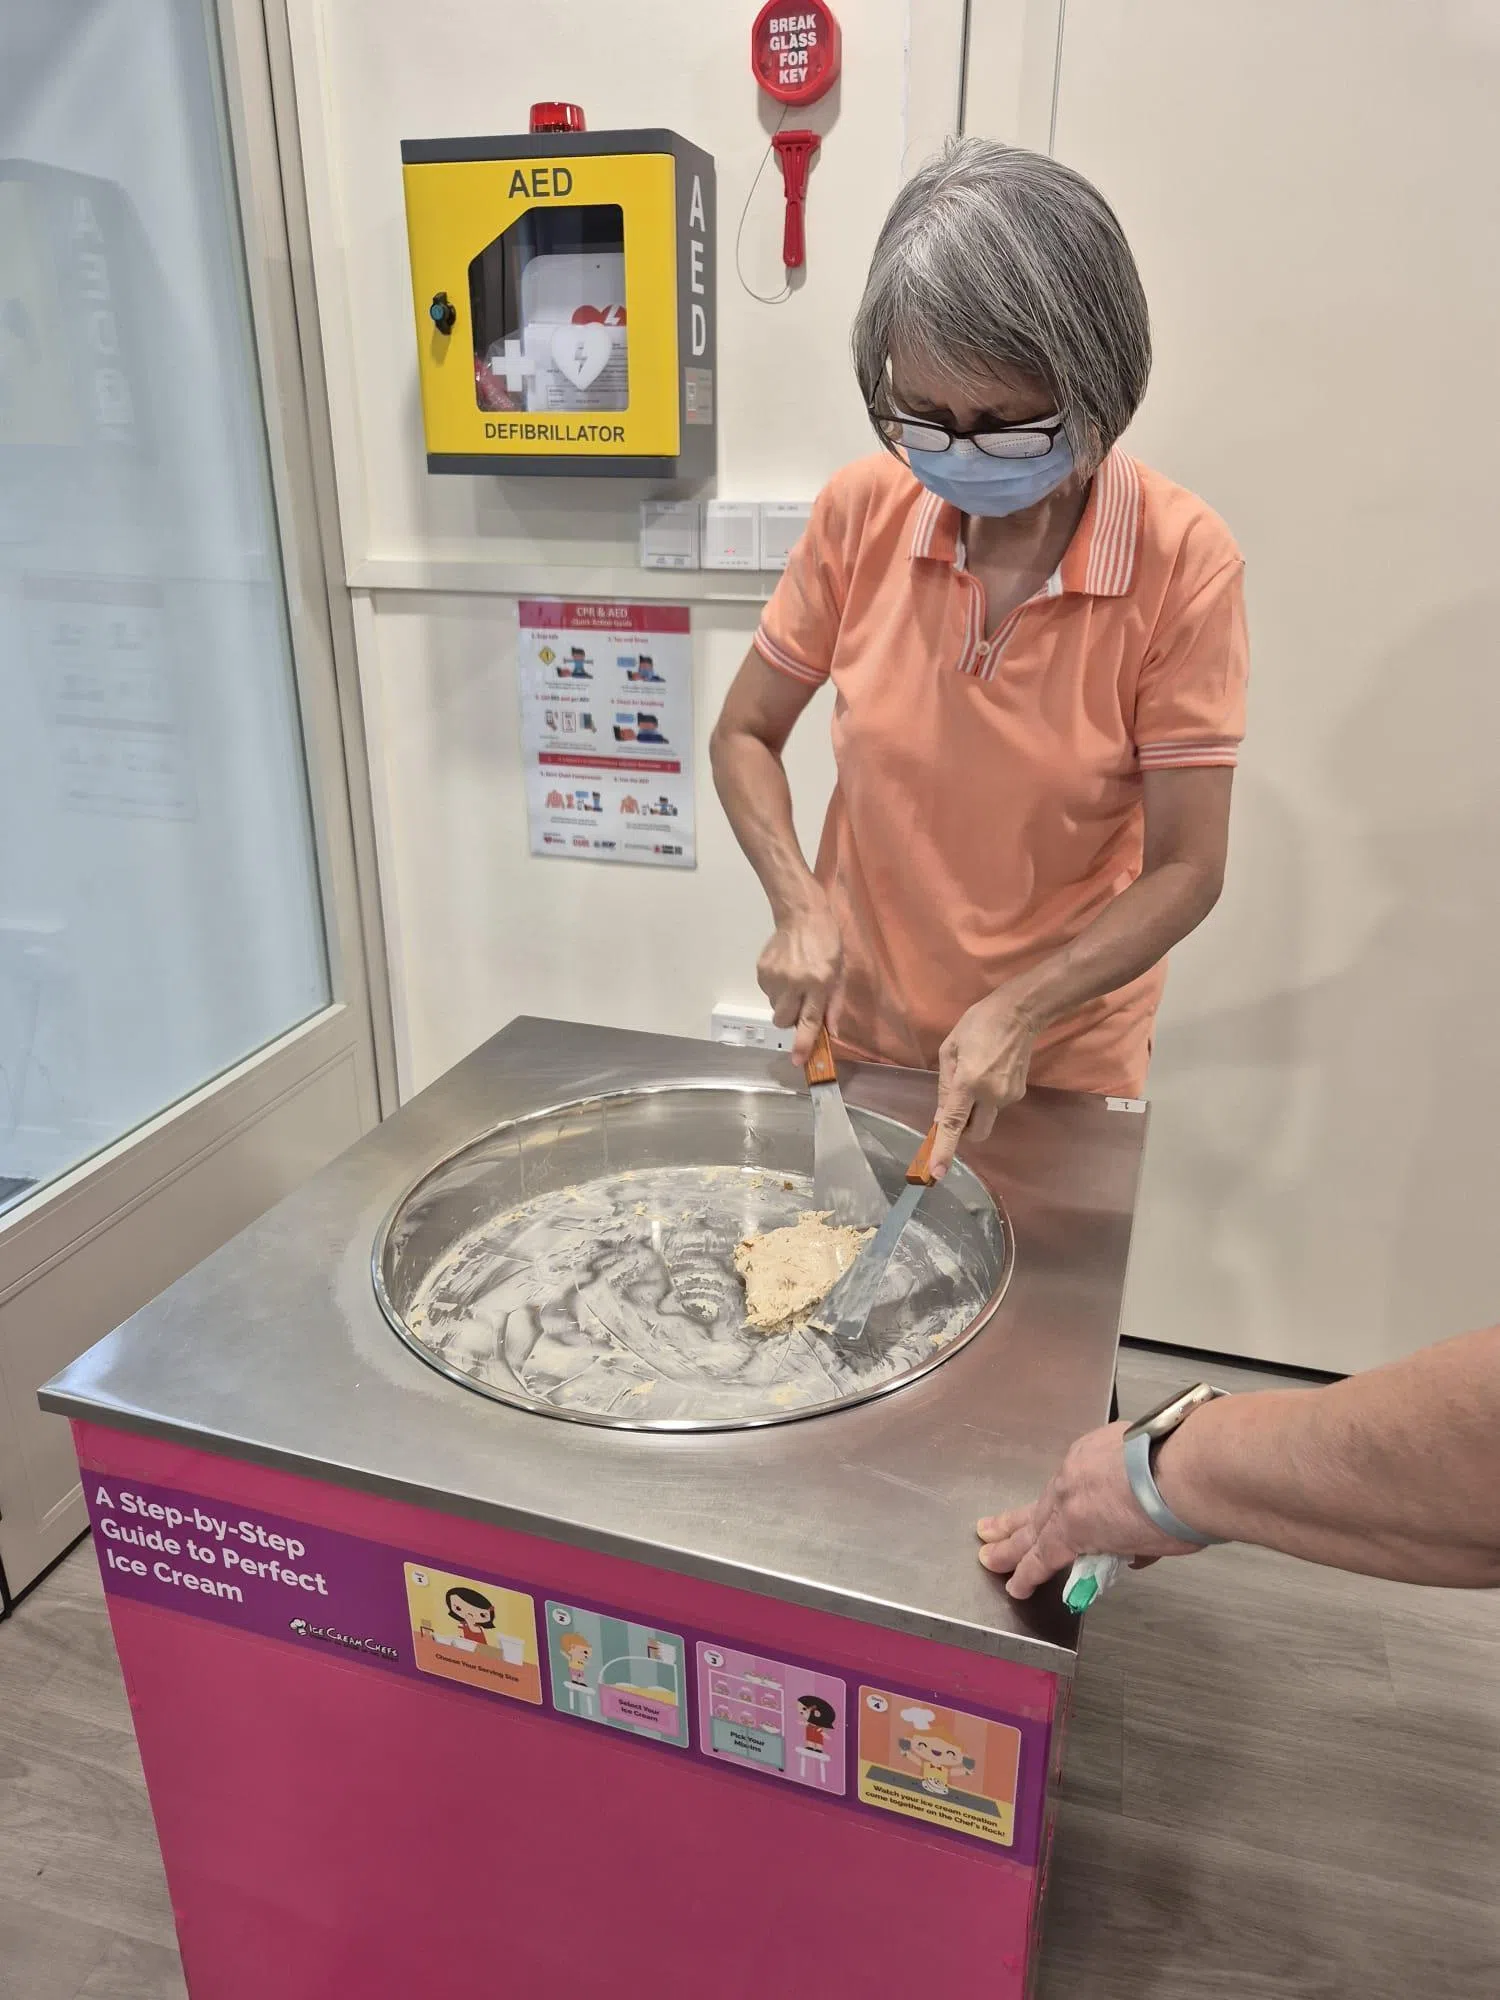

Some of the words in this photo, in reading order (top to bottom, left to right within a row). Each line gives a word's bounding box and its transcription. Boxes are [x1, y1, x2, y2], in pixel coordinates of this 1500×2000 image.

[769, 13, 817, 34] BREAK
[769, 31, 818, 51] GLASS
[779, 50, 809, 67] FOR
[779, 66, 809, 84] KEY
[508, 167, 574, 199] AED
[484, 422, 626, 443] DEFIBRILLATOR
[575, 606, 596, 617] CPR
[598, 607, 606, 617] &
[607, 608, 629, 618] AED
[95, 1485, 115, 1509] A
[119, 1491, 306, 1561] Step-by-Step
[100, 1517, 182, 1556] Guide
[186, 1538, 217, 1565] to
[222, 1547, 329, 1596] Perfect
[106, 1547, 148, 1577] Ice
[153, 1562, 244, 1604] Cream
[435, 1653, 461, 1665] Choose
[461, 1660, 477, 1670] Your
[477, 1665, 504, 1679] Serving
[503, 1673, 520, 1682] Size
[618, 1699, 642, 1711] Select
[643, 1705, 660, 1715] Your
[621, 1706, 633, 1715] Ice
[633, 1710, 659, 1723] Cream
[730, 1731, 746, 1741] Pick
[747, 1736, 765, 1747] Your
[865, 1791, 888, 1801] come
[889, 1797, 925, 1812] together
[938, 1811, 953, 1821] the
[954, 1816, 981, 1830] Chef's
[982, 1825, 1006, 1838] Rock!
[872, 1784, 900, 1798] Watch
[900, 1793, 920, 1803] your
[920, 1799, 933, 1807] ice
[934, 1804, 962, 1816] cream
[962, 1813, 998, 1828] creation
